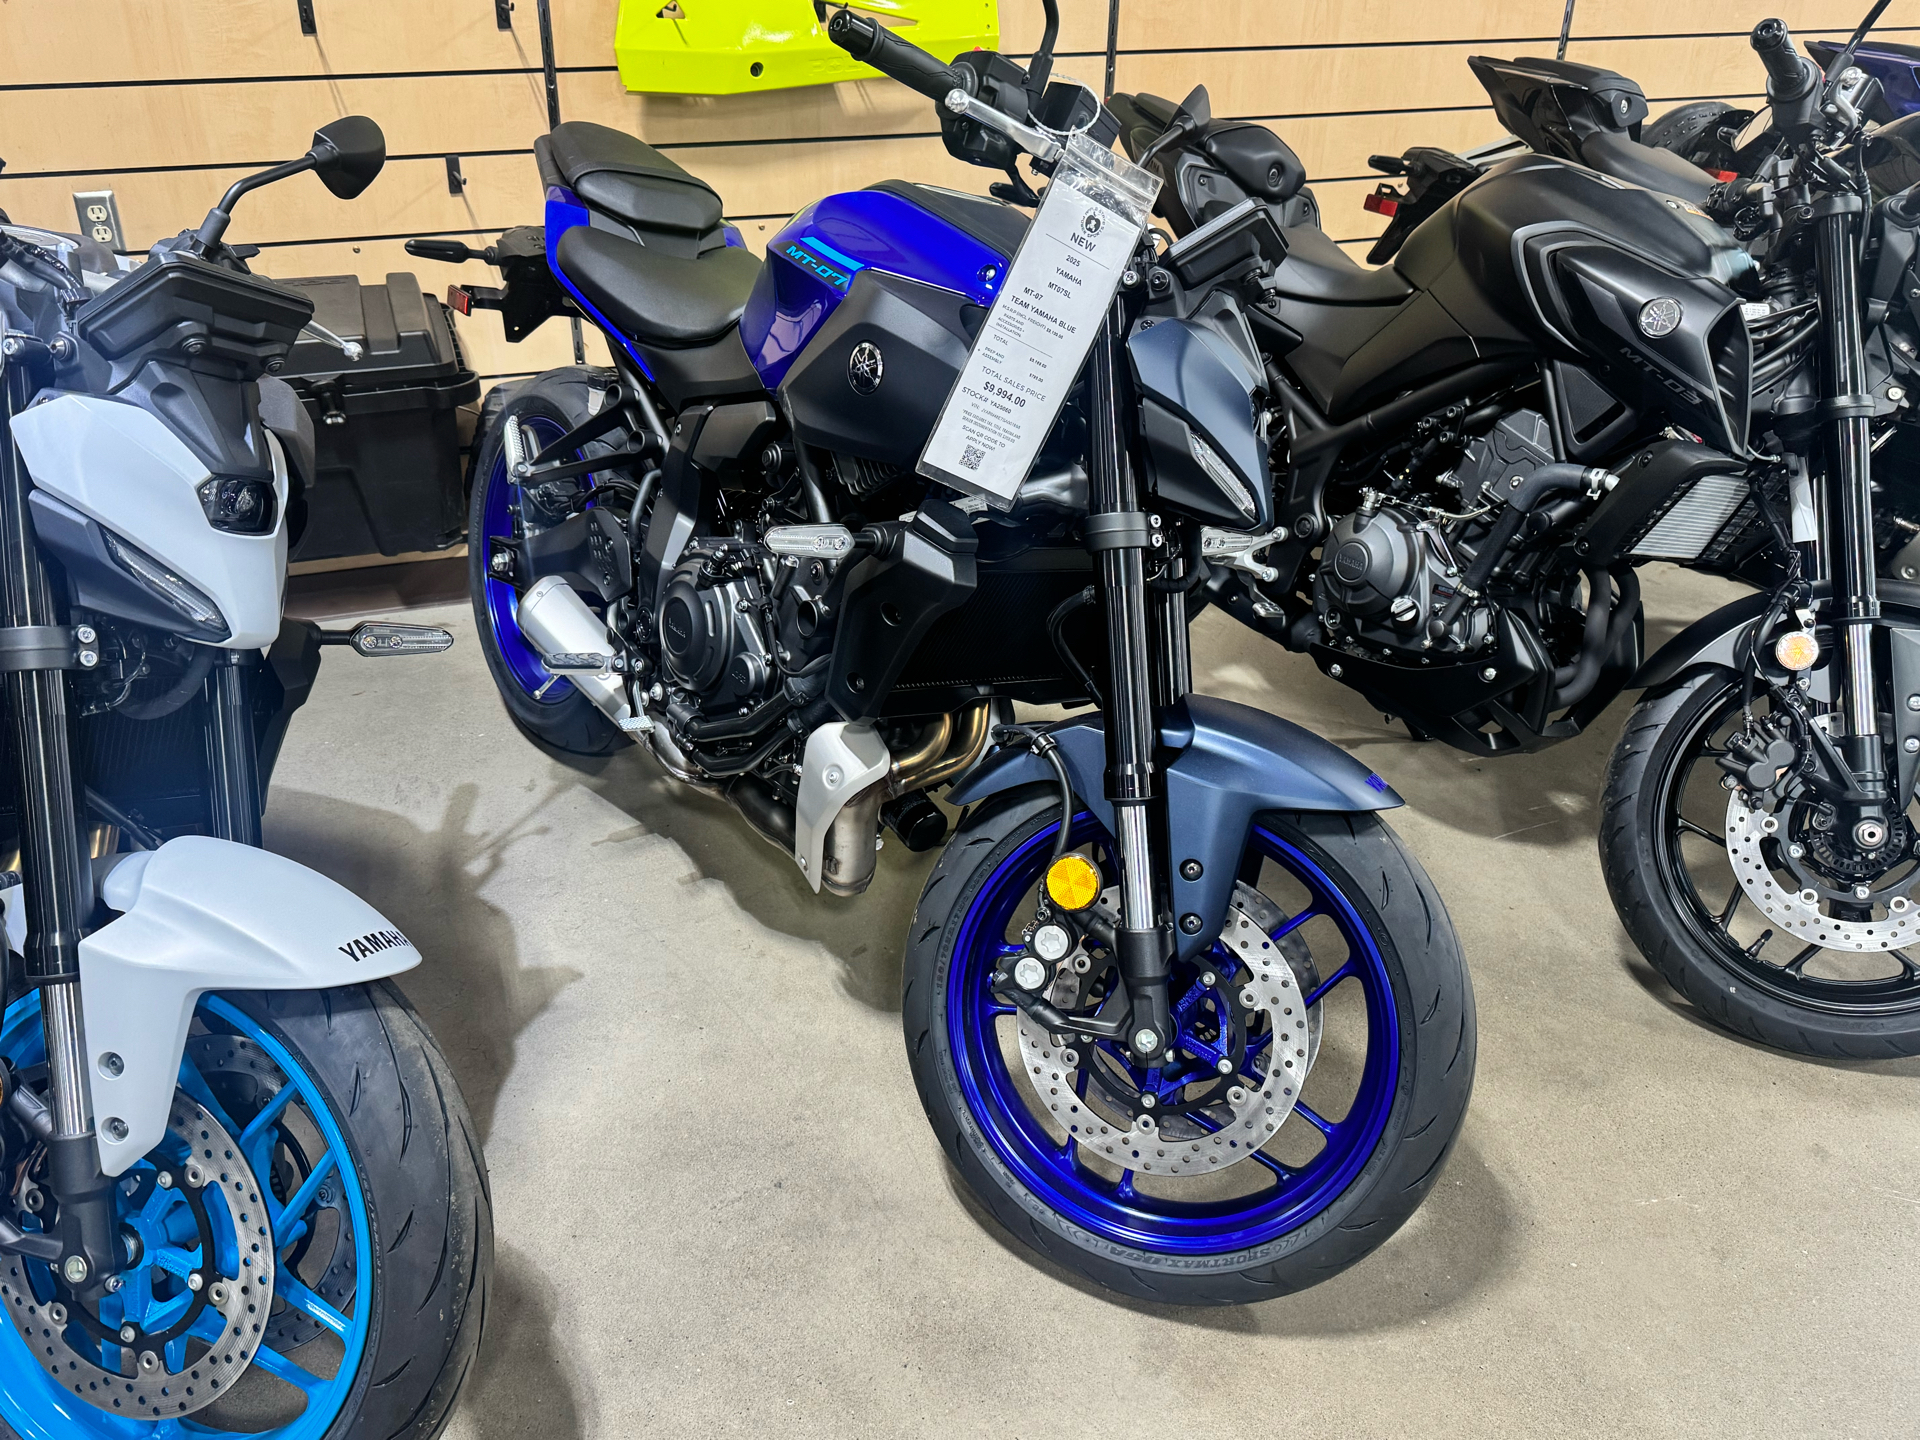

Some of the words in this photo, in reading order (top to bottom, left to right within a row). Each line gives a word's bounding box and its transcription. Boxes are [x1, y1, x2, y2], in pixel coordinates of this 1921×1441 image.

[1070, 232, 1096, 252] NEW
[786, 246, 848, 286] MT-07
[1066, 255, 1081, 267] 2025
[1056, 267, 1082, 286] YAMAHA
[1024, 287, 1044, 300] MT-07
[1048, 282, 1071, 299] MT07SL
[1011, 295, 1030, 309] TEAM
[1031, 305, 1058, 324] YAMAHA
[1058, 320, 1077, 334] BLUE
[994, 334, 1008, 346] TOTAL
[982, 366, 1002, 381] TOTAL
[1003, 377, 1026, 391] SALES
[1025, 388, 1046, 402] PRICE
[1619, 347, 1703, 405] MT-03
[962, 387, 989, 403] STOCK#
[983, 381, 1026, 408] $9,994.00
[962, 425, 976, 434] SCAN
[984, 435, 998, 445] CODE
[966, 435, 982, 445] APPLY
[338, 930, 413, 962] YAMAHA
[1166, 1247, 1272, 1268] SPORTMAX
